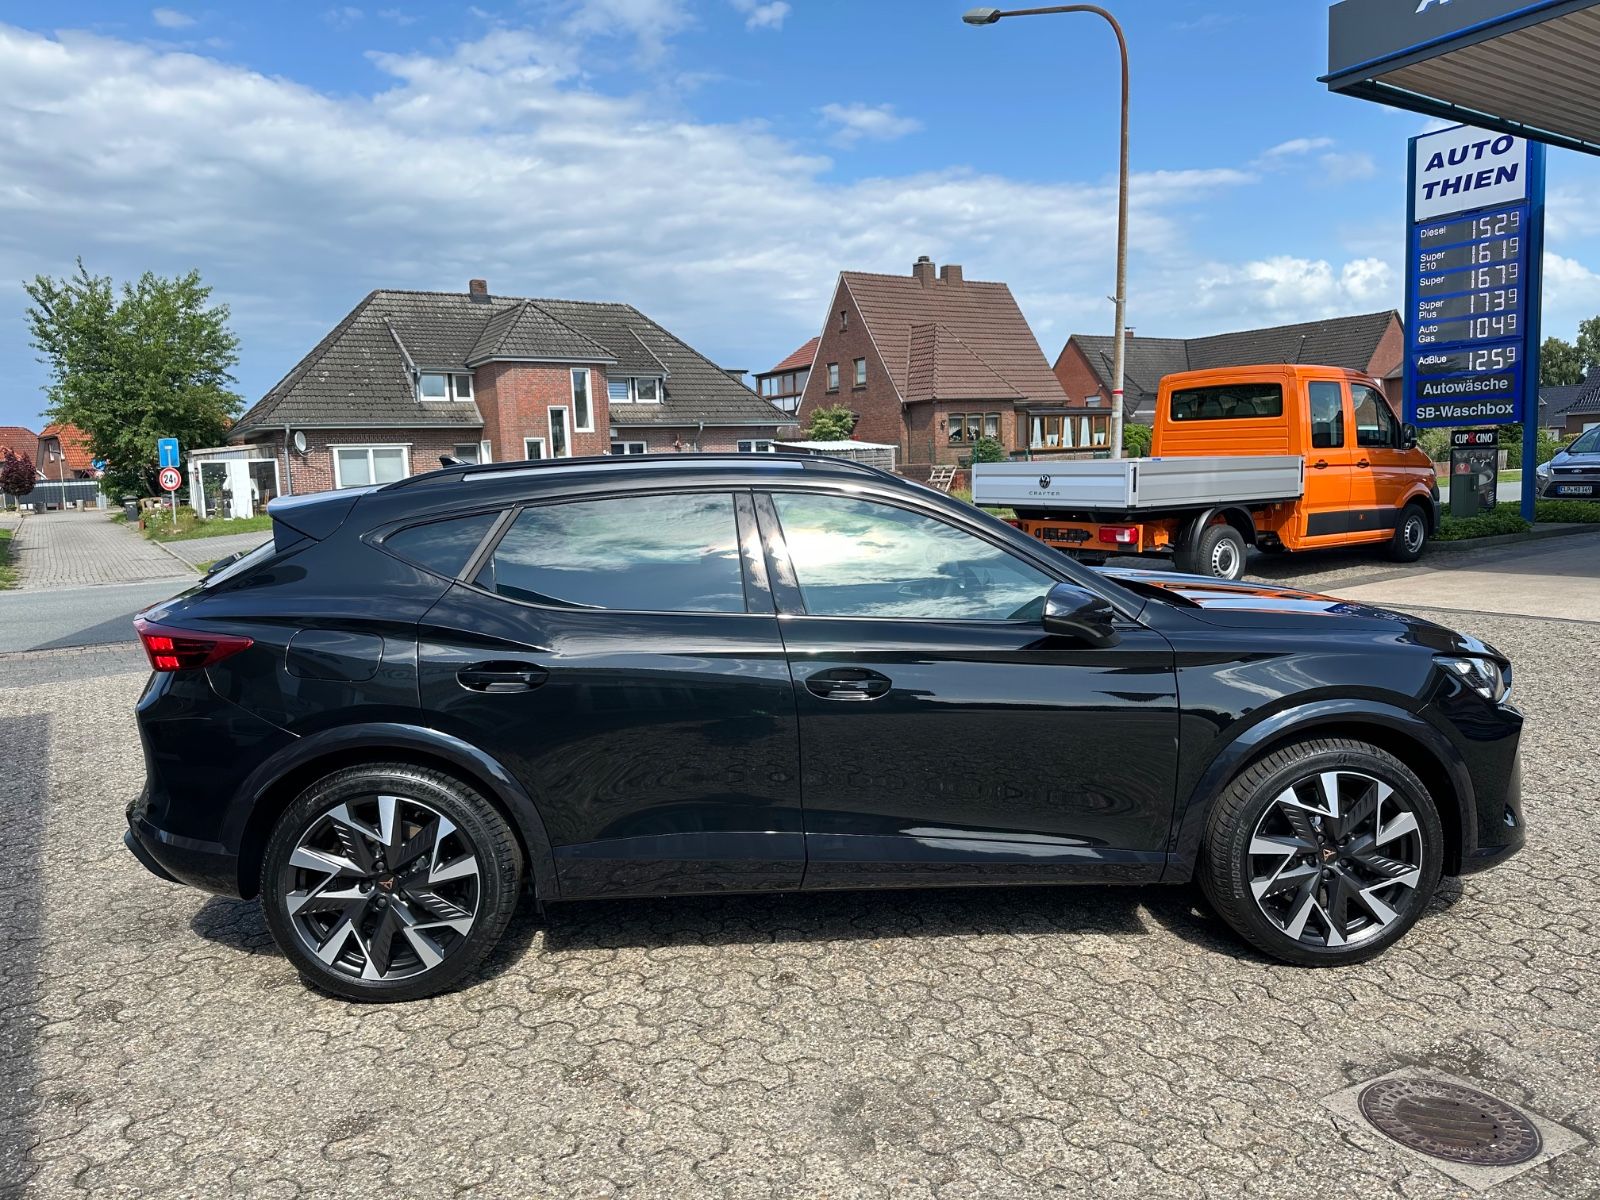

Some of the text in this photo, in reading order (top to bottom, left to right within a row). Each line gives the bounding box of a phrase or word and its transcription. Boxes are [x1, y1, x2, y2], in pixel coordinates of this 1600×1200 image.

[1424, 135, 1514, 172] AUTO
[1422, 163, 1519, 200] THIEN
[1420, 211, 1520, 239] Diesel 1529
[1420, 237, 1519, 265] Super 1619
[1420, 262, 1436, 272] E10
[1420, 263, 1518, 289] Super 1679
[1419, 288, 1517, 314] Super 1739
[1418, 311, 1437, 320] Plus
[1418, 314, 1516, 339] Auto 1049
[1418, 335, 1435, 343] Gas
[1418, 347, 1516, 371] AdBlue 1259
[1423, 377, 1508, 395] Autowäsche
[1416, 403, 1514, 419] SB-Waschbox
[1455, 431, 1493, 444] CUP&CINO
[1231, 820, 1248, 899] BRIDGESTONE
